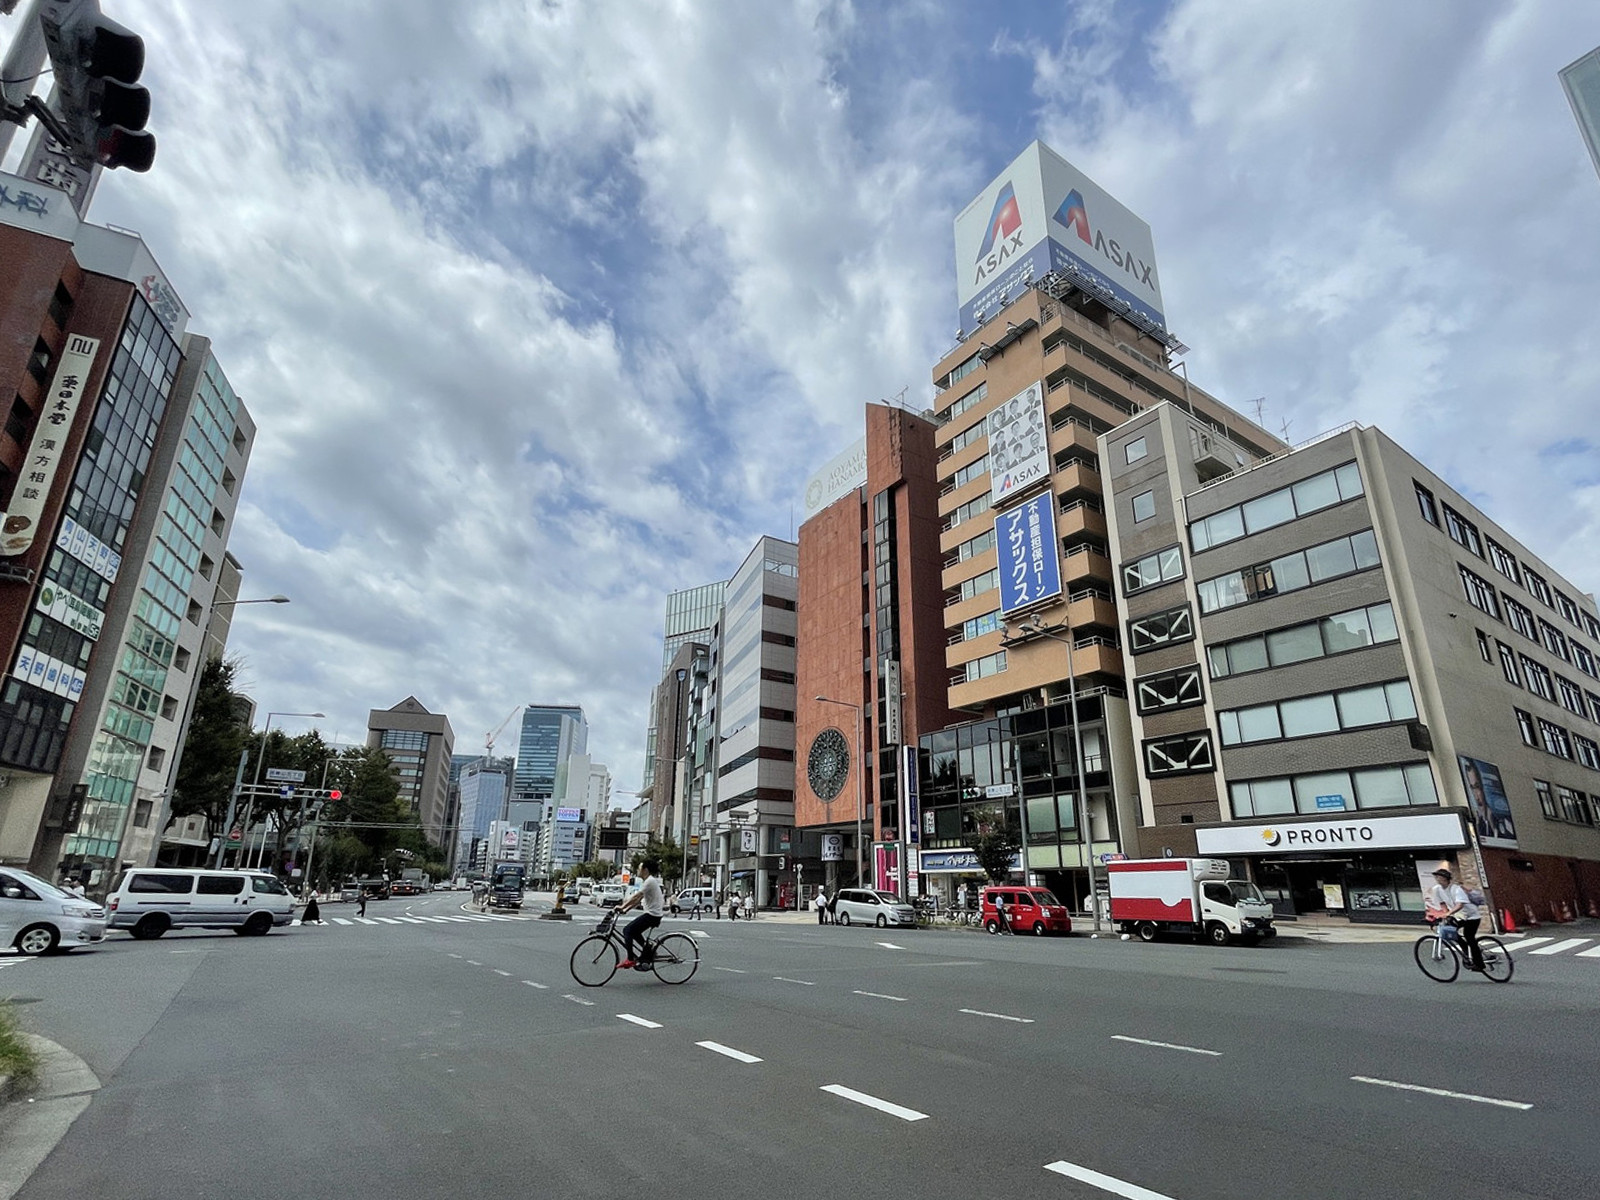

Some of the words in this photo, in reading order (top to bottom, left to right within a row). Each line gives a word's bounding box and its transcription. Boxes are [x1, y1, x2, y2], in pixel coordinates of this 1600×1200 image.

[975, 229, 1024, 285] ASAX
[1095, 229, 1155, 291] ASAX
[22, 438, 56, 500] 漢方相談
[1012, 463, 1041, 486] ASAX
[59, 535, 115, 579] クリニック
[1006, 509, 1029, 605] アサックス
[1028, 501, 1046, 597] 不動産担保ローン
[19, 656, 69, 687] 天野歯科
[1287, 826, 1373, 845] PRONTO
